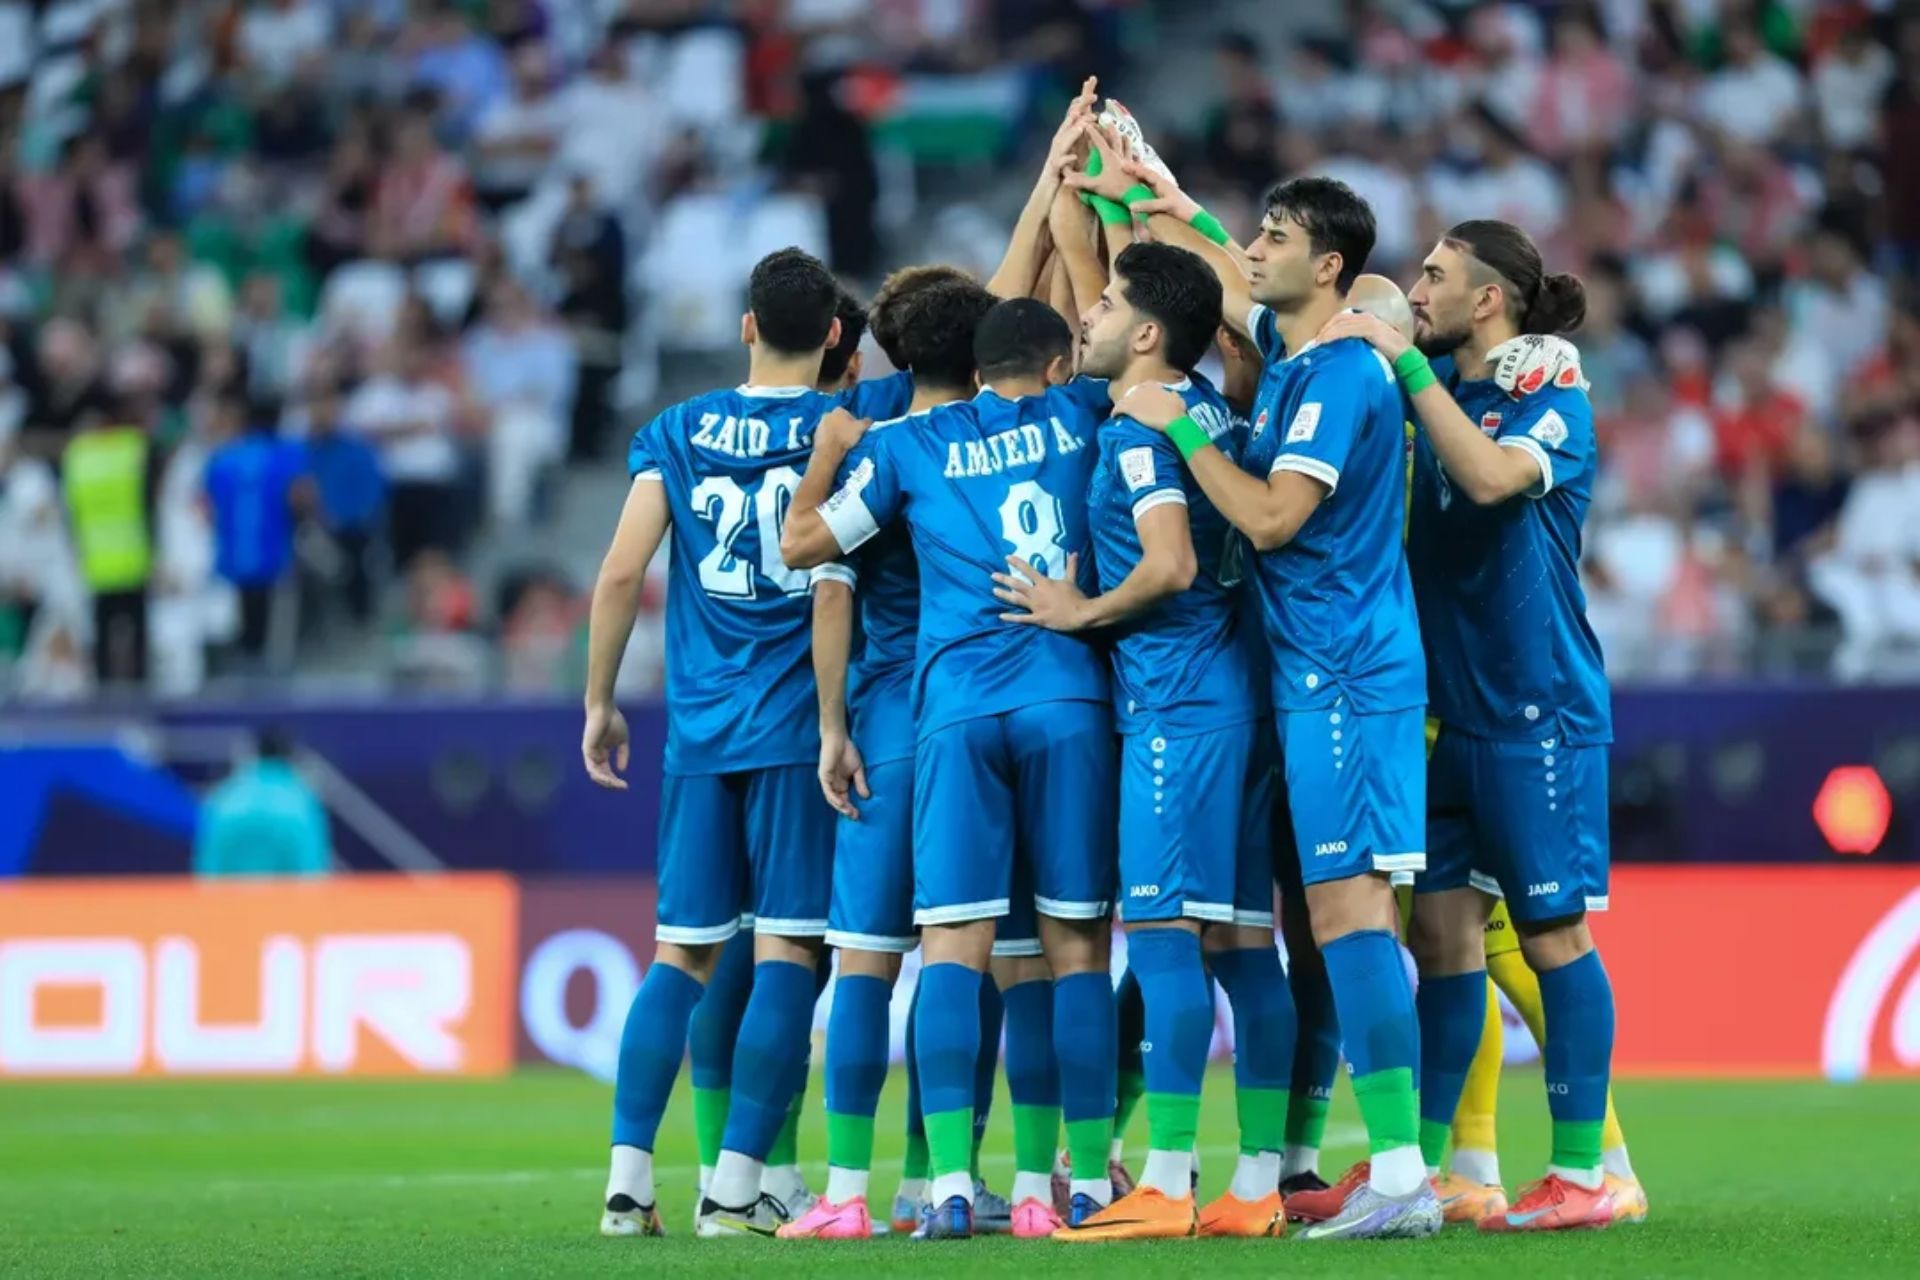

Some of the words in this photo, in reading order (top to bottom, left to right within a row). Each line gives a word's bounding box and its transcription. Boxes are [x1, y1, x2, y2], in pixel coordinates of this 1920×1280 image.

[690, 412, 770, 458] ZAID
[787, 417, 811, 450] I.
[944, 423, 1046, 479] AMJED
[1050, 416, 1086, 455] A.
[691, 466, 812, 600] 20
[998, 480, 1067, 586] 8
[1314, 840, 1348, 856] JAKO
[1130, 884, 1159, 897] JAKO
[1527, 881, 1559, 897] JAKO
[0, 935, 472, 1073] OUR
[1547, 1082, 1569, 1095] KO
